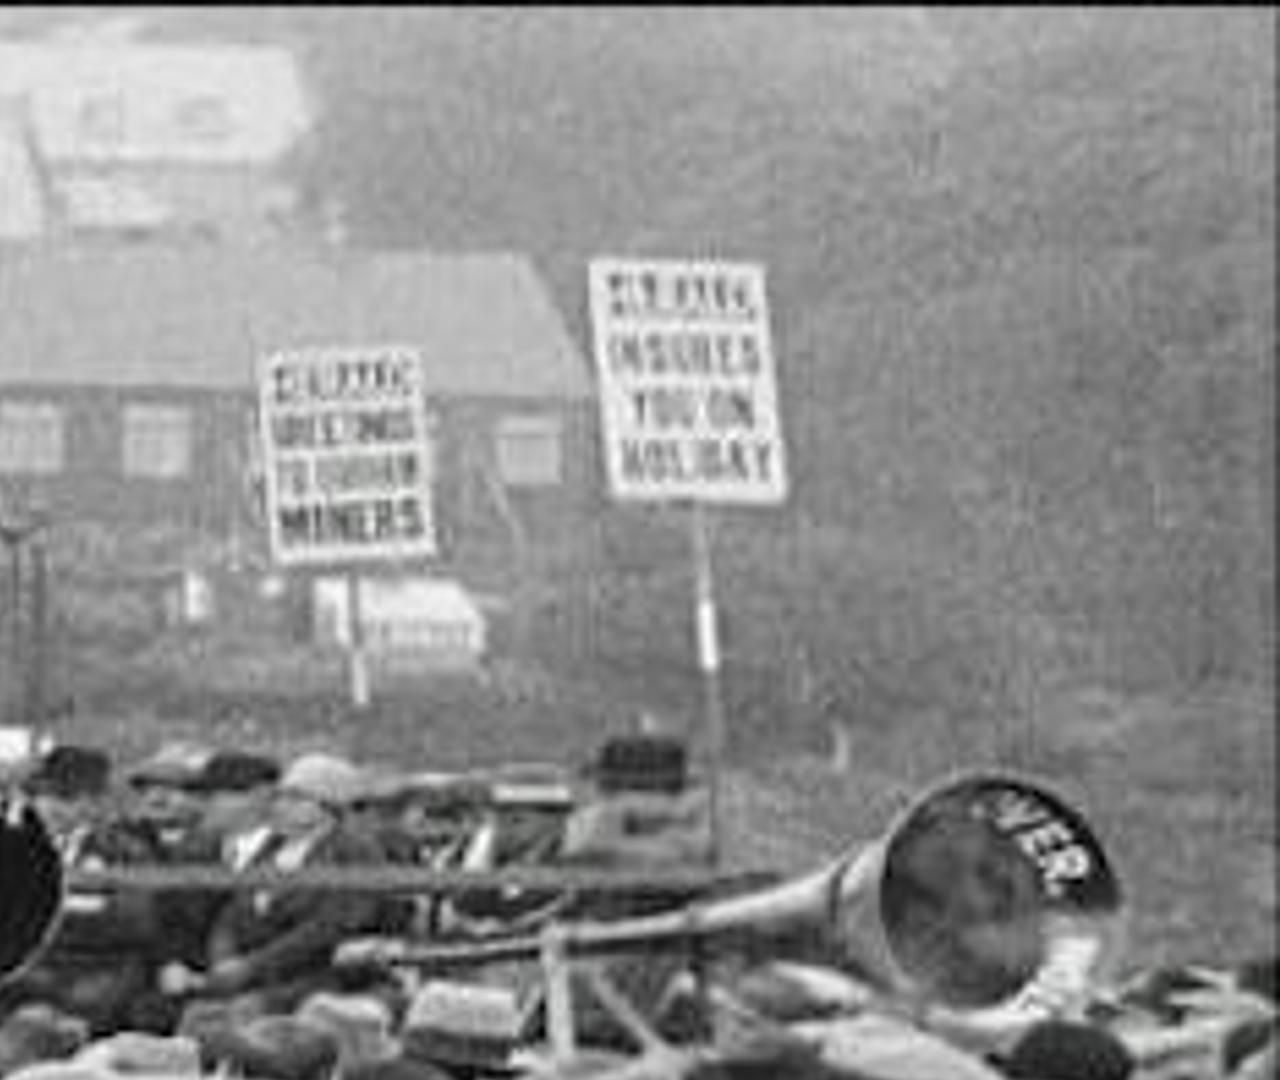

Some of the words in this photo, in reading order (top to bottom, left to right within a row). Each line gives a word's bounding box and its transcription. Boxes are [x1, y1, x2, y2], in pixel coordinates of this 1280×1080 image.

[628, 388, 692, 429] YOU
[706, 387, 756, 431] ON
[620, 437, 773, 484] HOLIDAY
[280, 499, 425, 547] MINERS
